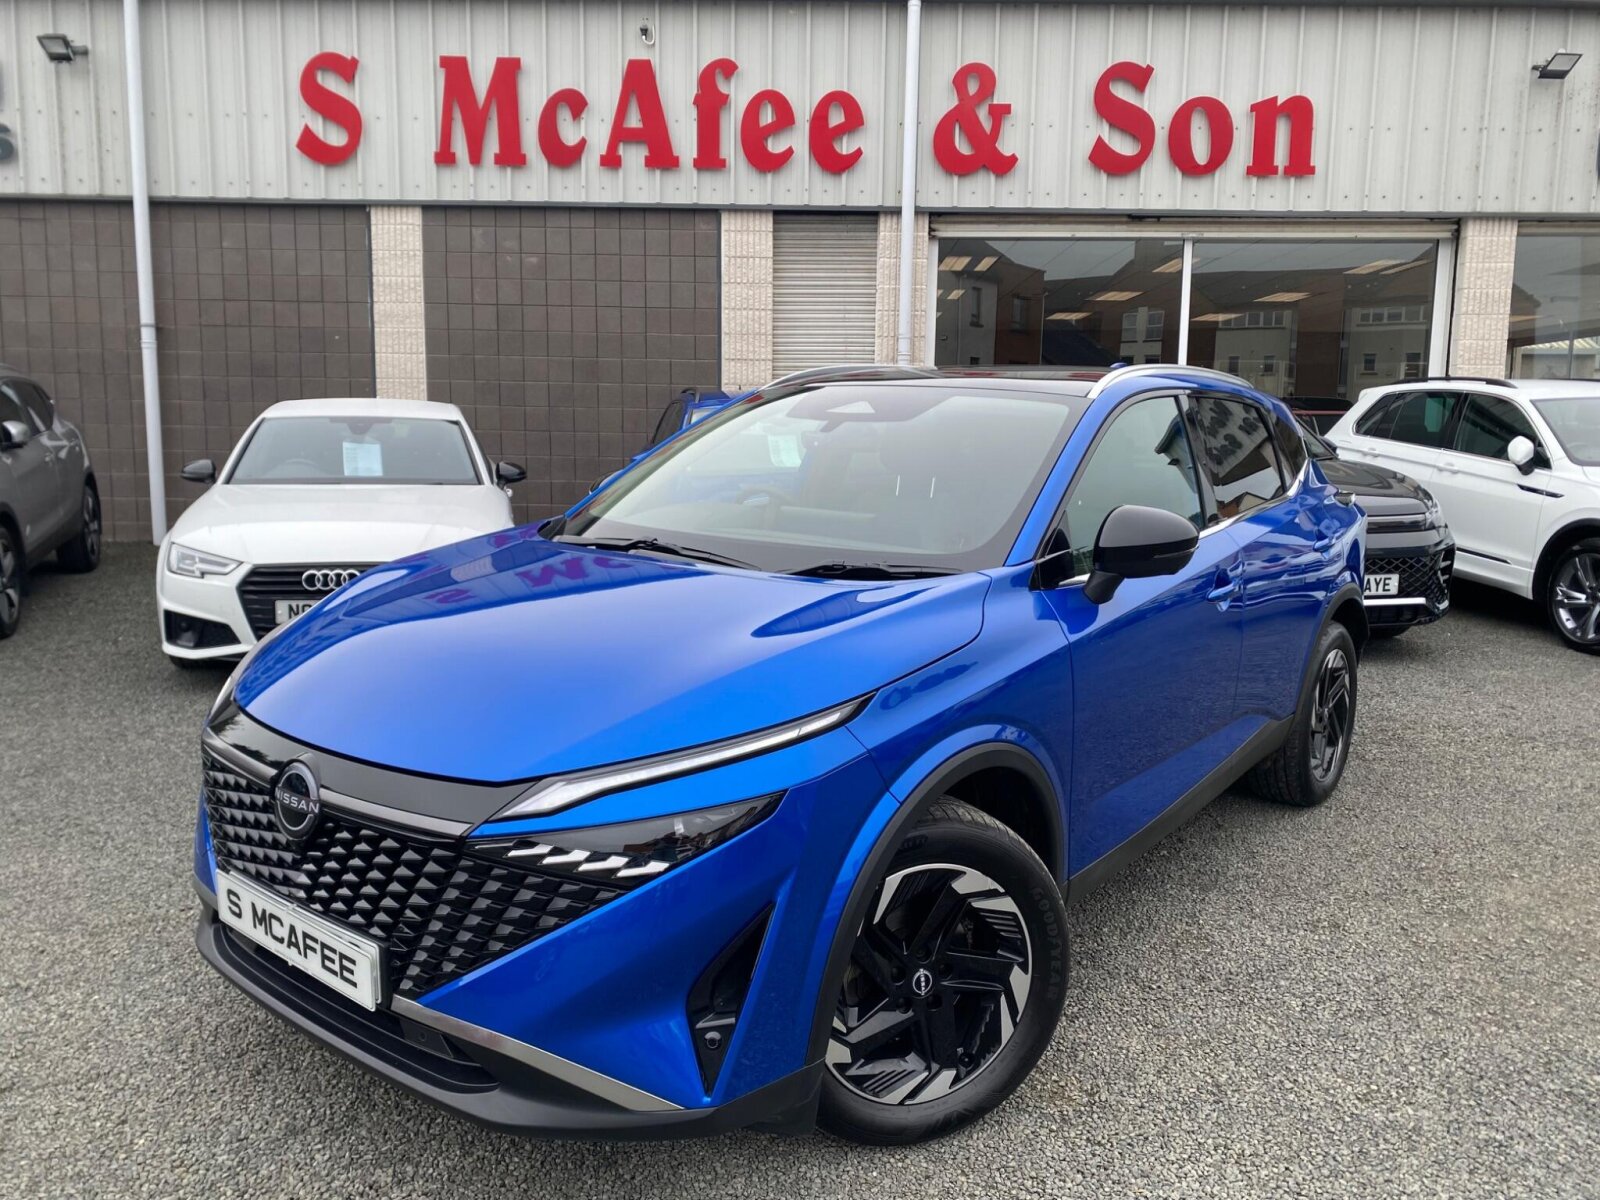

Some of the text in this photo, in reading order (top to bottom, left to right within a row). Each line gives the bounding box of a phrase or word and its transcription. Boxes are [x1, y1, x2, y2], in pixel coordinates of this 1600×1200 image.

[297, 52, 1316, 176] S McAfee & Son
[1364, 577, 1392, 593] AYE
[275, 786, 319, 813] NISSAN
[226, 888, 358, 989] S MCAFEE
